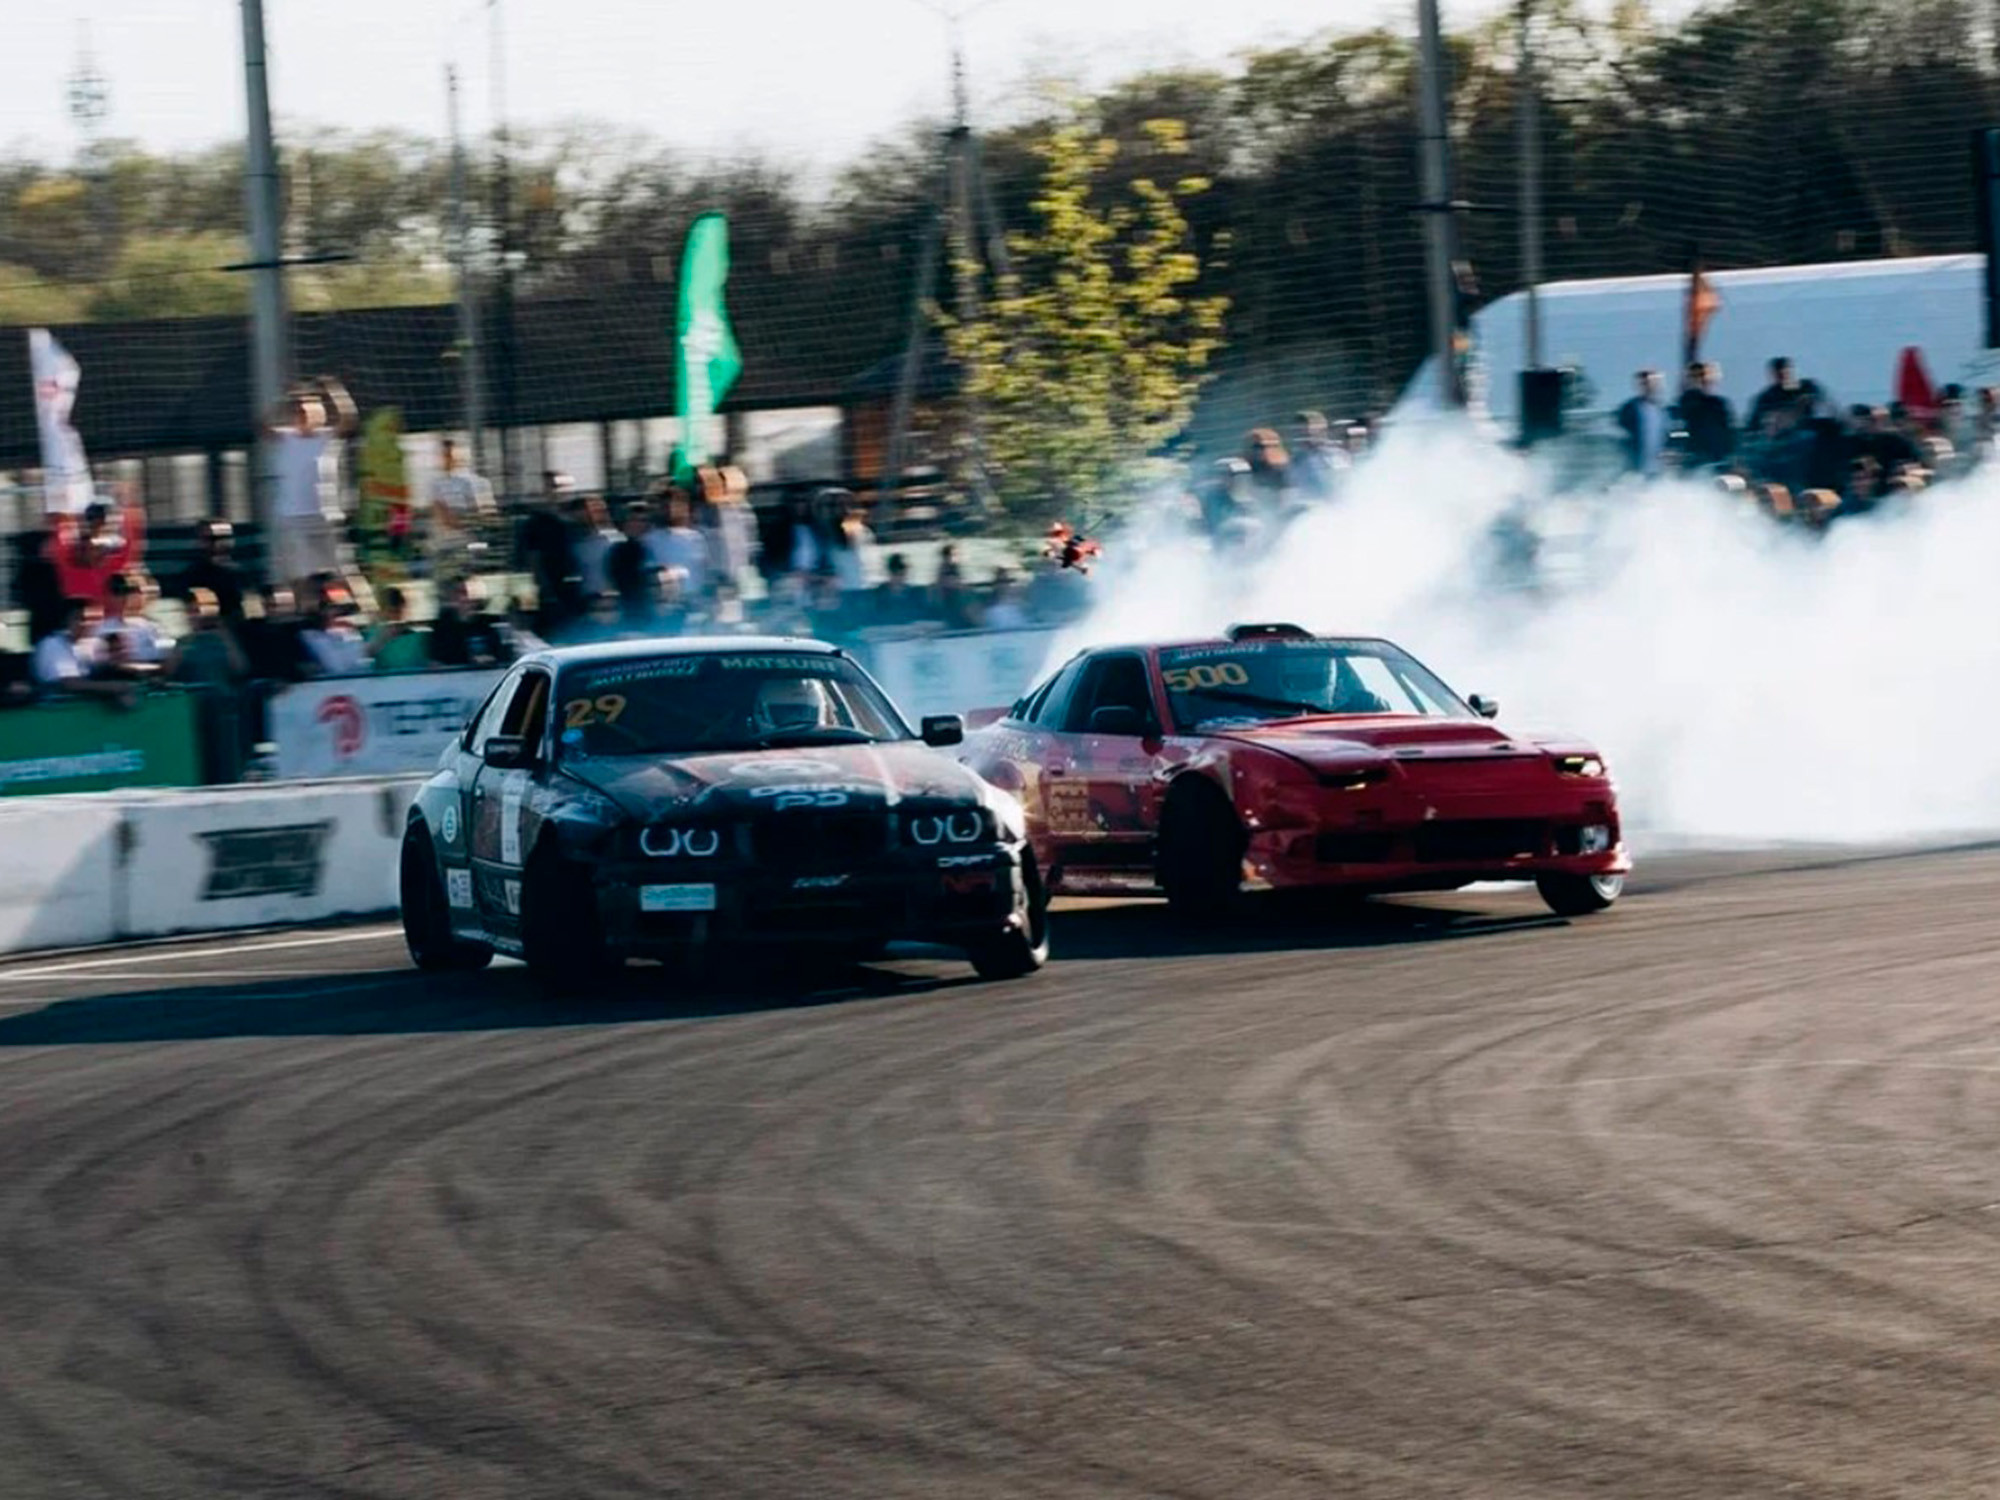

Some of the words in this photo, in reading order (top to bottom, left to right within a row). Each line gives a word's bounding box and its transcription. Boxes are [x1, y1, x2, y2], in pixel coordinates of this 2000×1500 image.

[720, 657, 837, 672] MATSURI
[1163, 663, 1248, 692] 500
[563, 694, 628, 727] 29
